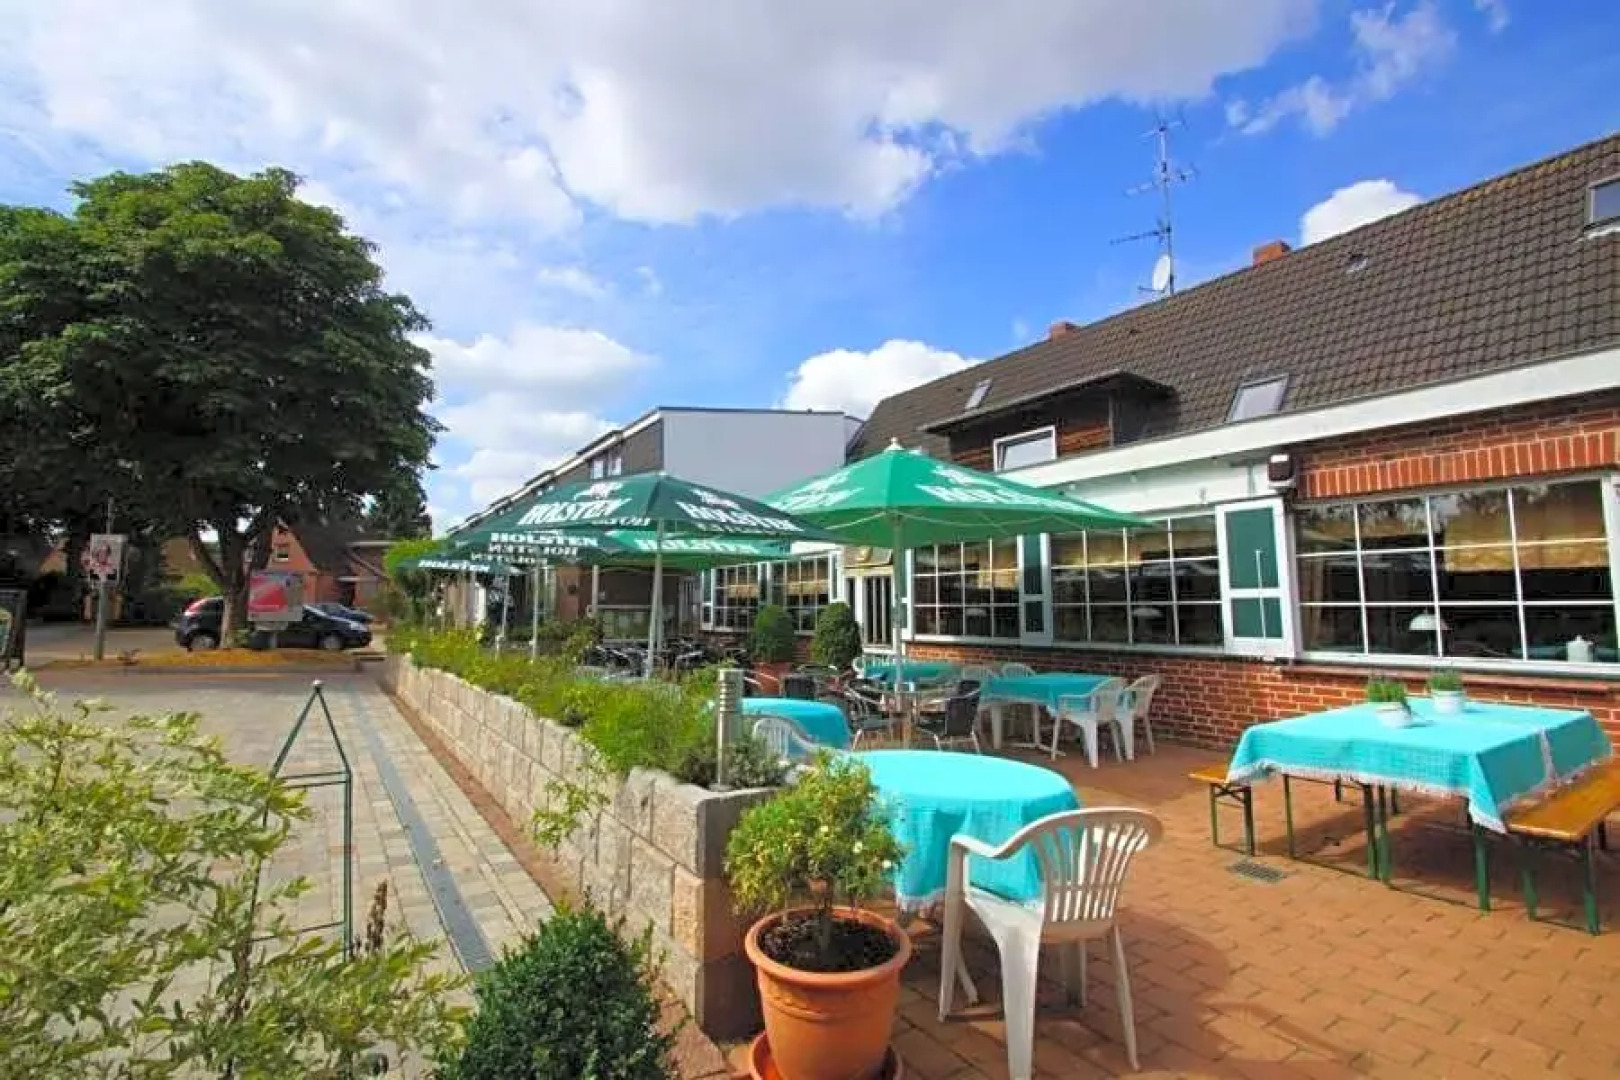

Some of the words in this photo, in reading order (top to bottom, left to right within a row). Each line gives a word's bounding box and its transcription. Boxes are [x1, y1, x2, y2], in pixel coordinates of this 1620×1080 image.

[517, 498, 632, 525] HOLSTEN
[676, 501, 804, 532] HOLSTEN
[489, 532, 598, 548] HOLSTEN
